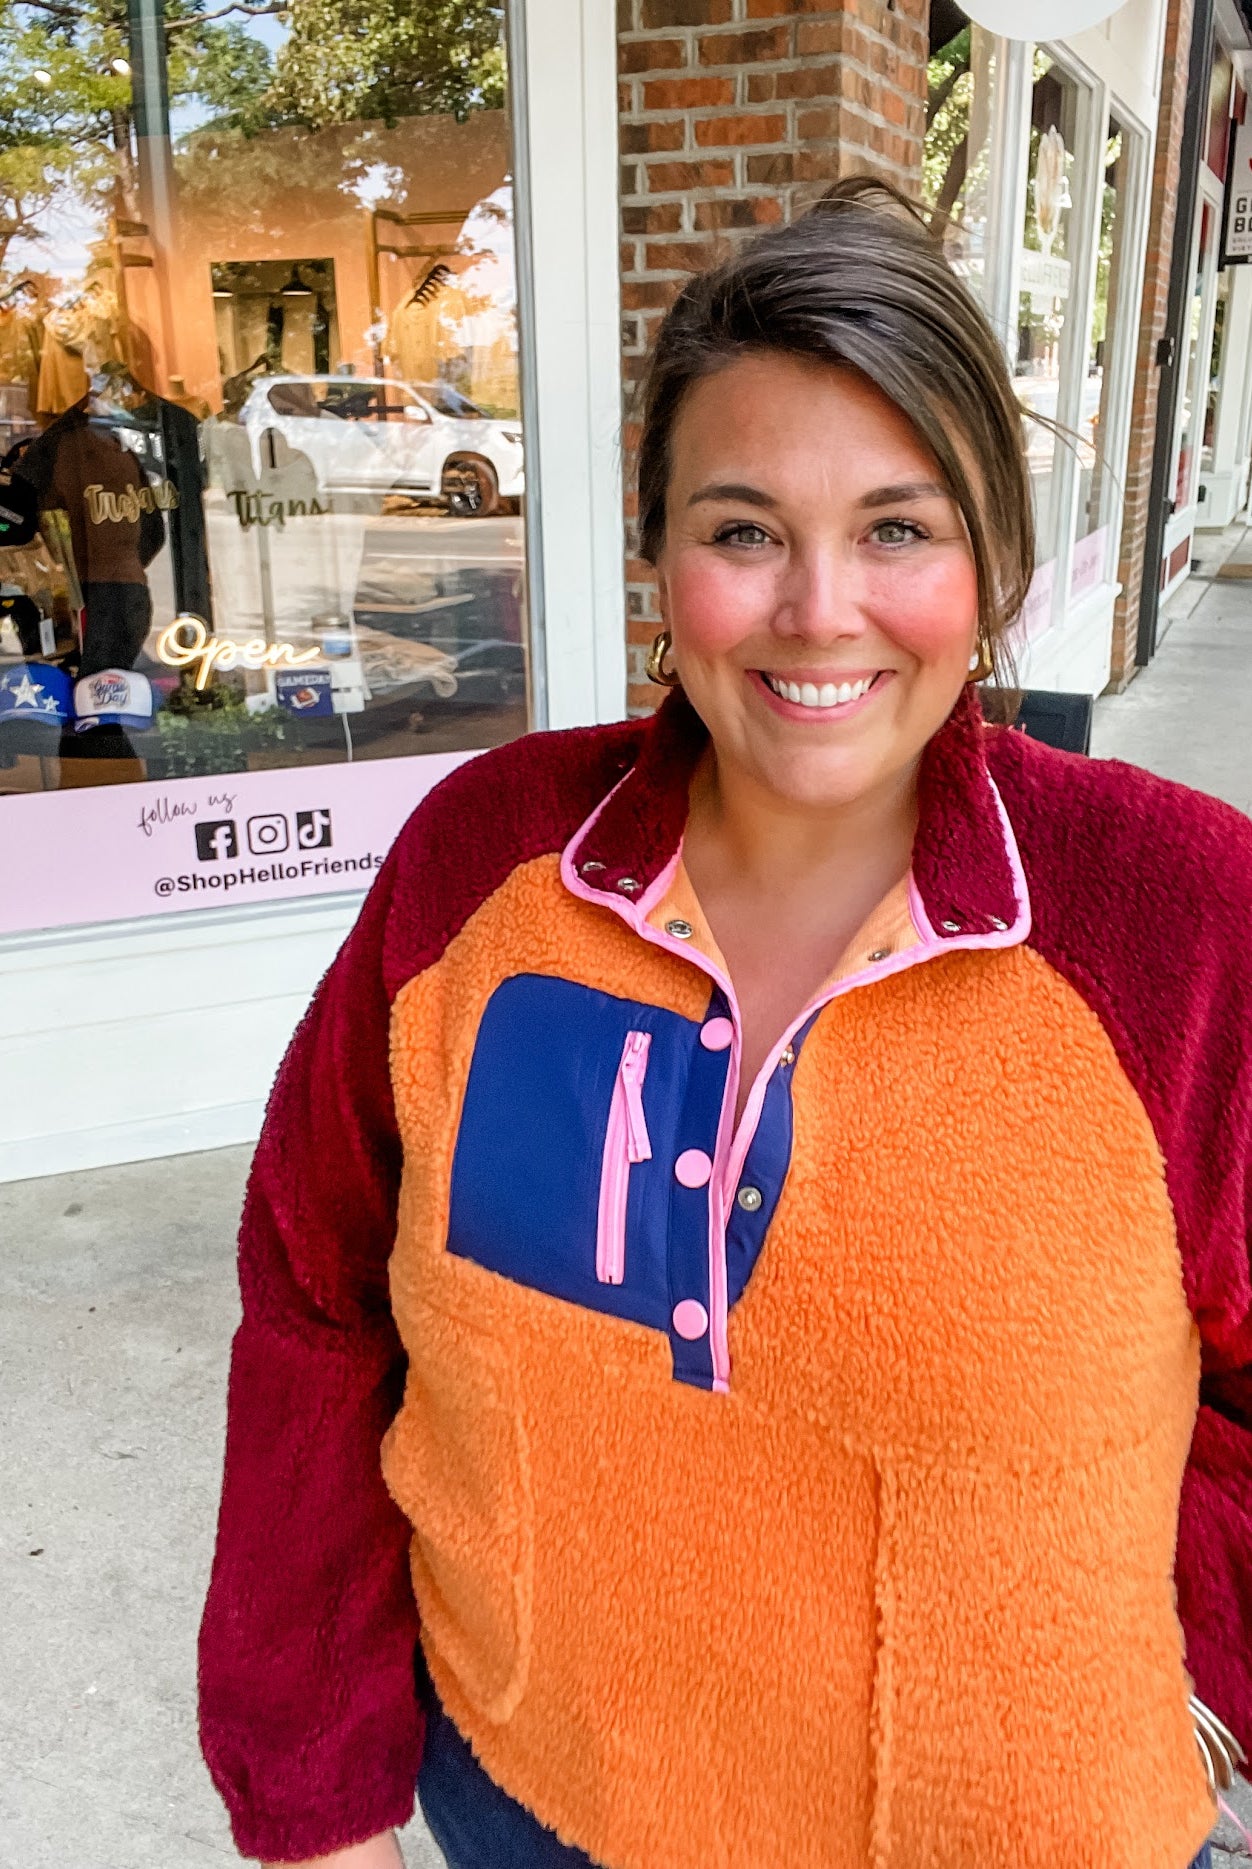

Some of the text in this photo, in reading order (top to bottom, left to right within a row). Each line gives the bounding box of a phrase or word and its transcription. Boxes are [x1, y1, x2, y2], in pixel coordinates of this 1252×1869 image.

[1236, 197, 1252, 213] G
[226, 489, 330, 528] Titans
[156, 616, 321, 691] Open
[137, 791, 239, 837] follow us
[154, 852, 384, 897] @ShopHelloFriends
